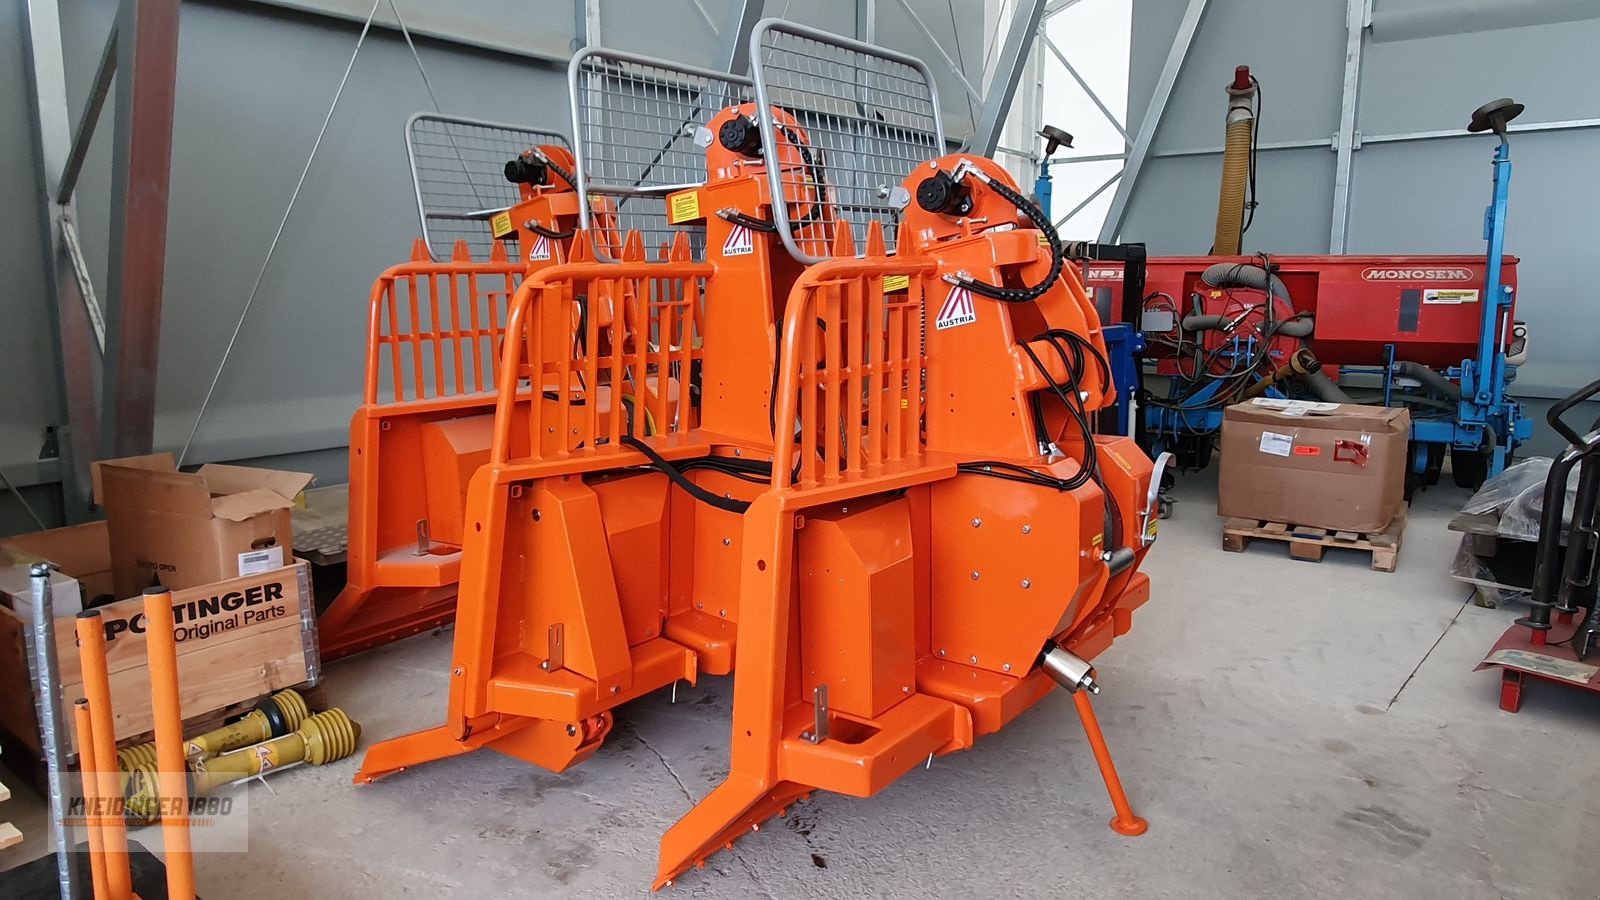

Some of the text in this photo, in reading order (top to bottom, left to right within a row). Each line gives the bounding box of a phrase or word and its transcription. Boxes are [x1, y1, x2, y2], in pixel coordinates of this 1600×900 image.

[724, 246, 752, 255] AUSTRIA
[1366, 270, 1468, 279] MONOSEM
[938, 315, 974, 328] AUSTRIA
[174, 605, 286, 642] Original Parts
